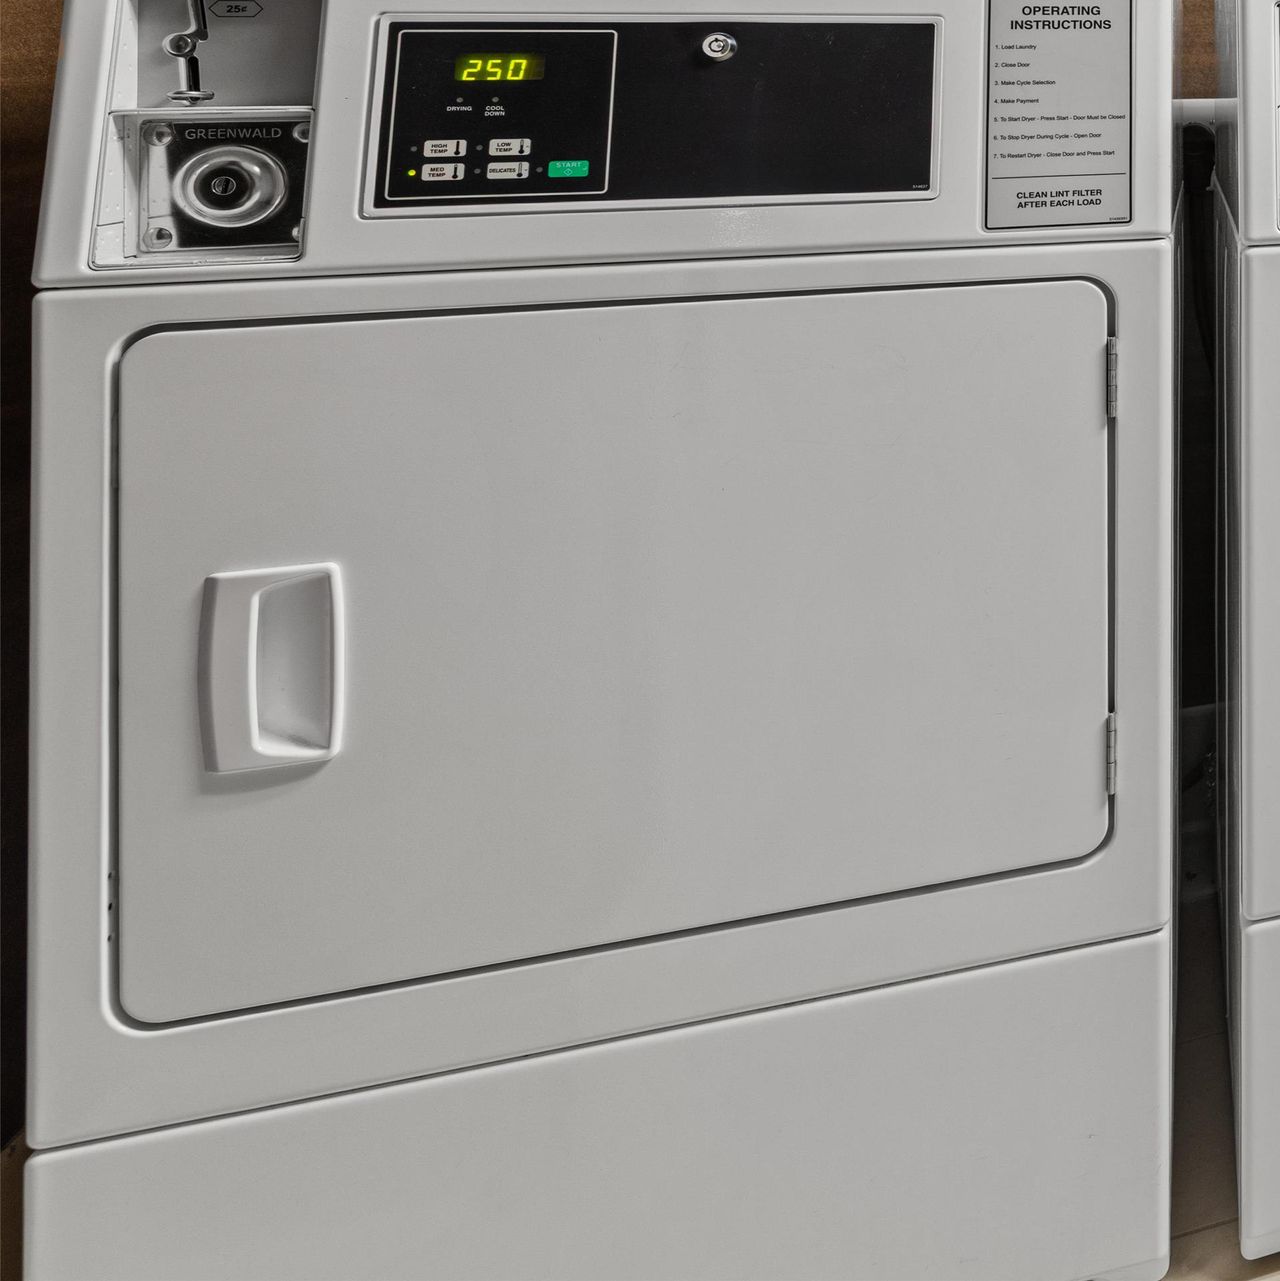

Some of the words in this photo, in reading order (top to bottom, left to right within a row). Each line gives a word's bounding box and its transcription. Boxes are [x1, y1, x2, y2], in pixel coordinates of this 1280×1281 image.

[226, 5, 248, 13] 25¢
[1022, 6, 1101, 16] OPERATING
[1010, 20, 1112, 30] INSTRUCTIONS
[462, 59, 528, 81] 250
[185, 128, 282, 140] GREENWALD
[1017, 200, 1047, 208] AFTER
